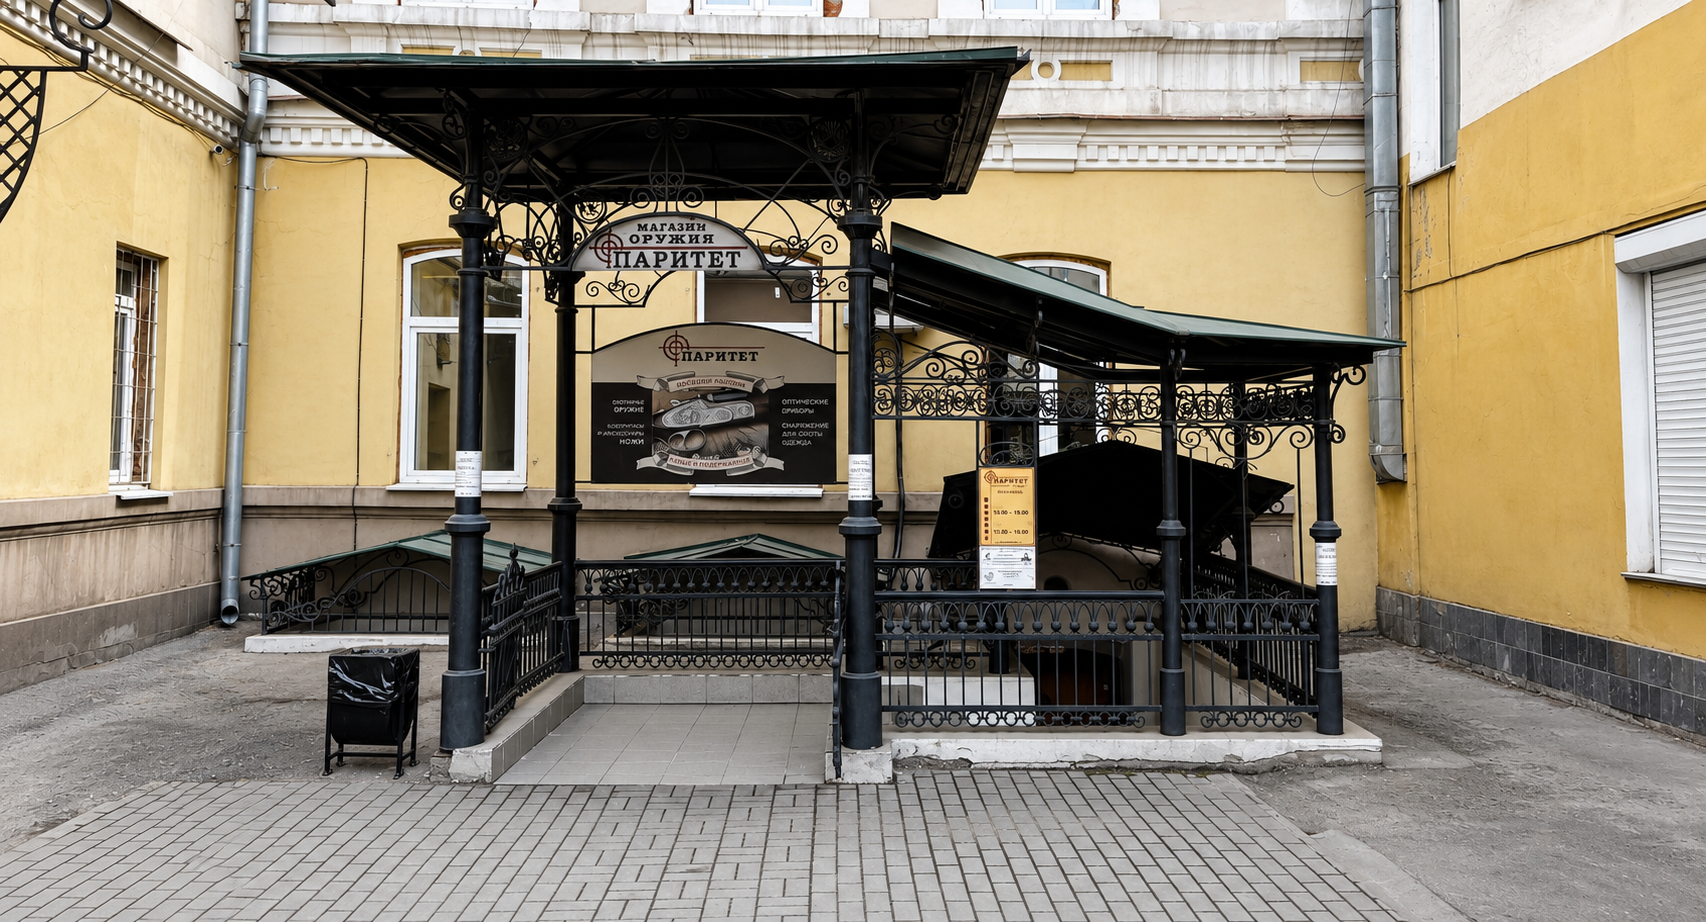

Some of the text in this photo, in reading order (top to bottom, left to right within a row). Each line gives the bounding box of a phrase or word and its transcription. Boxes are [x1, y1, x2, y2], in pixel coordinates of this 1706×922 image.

[637, 223, 706, 232] МАГАЗИН
[629, 234, 714, 244] ОРУЖИЯ
[613, 251, 741, 268] ПАРИТЕТ
[681, 351, 759, 362] ПАРИТЕТ
